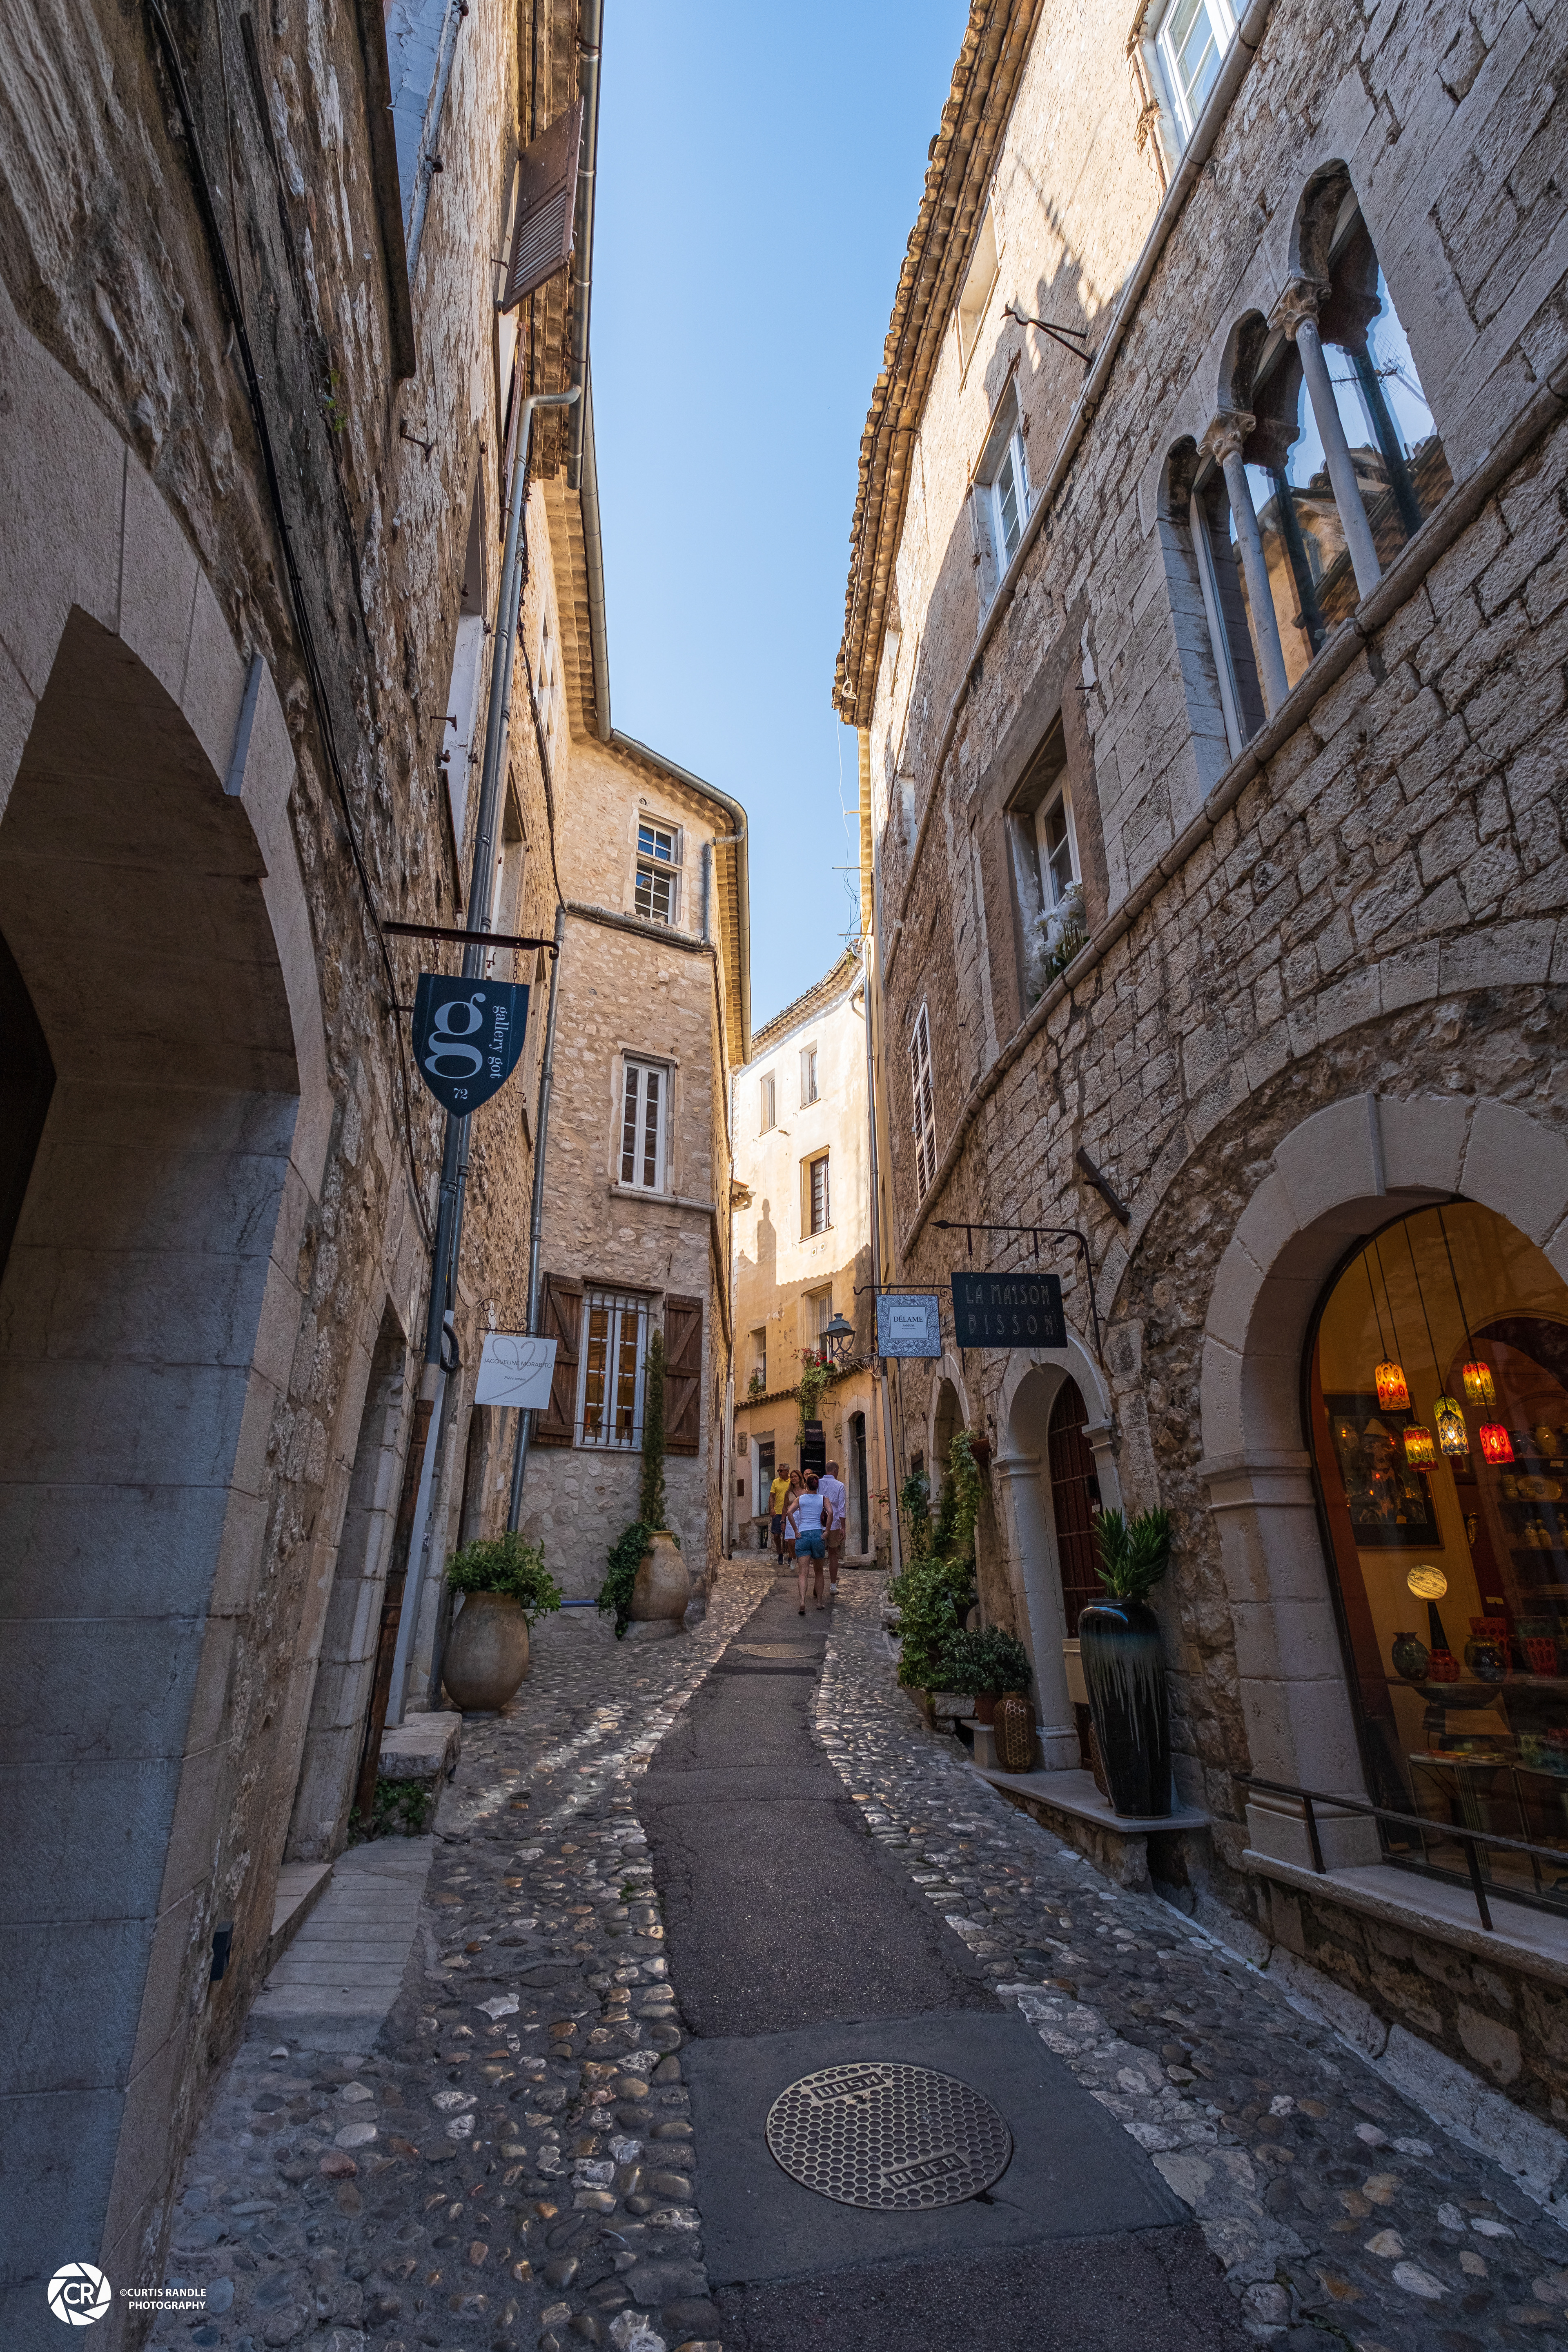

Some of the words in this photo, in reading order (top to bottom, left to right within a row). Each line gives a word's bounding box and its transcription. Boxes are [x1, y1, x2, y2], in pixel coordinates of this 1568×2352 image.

[489, 1005, 510, 1053] gallery
[488, 1056, 503, 1079] got
[453, 1088, 468, 1099] 72
[965, 1285, 983, 1304] LA
[991, 1285, 1050, 1305] MAISON
[968, 1314, 1054, 1335] BISSON
[890, 2157, 963, 2186] ACIER
